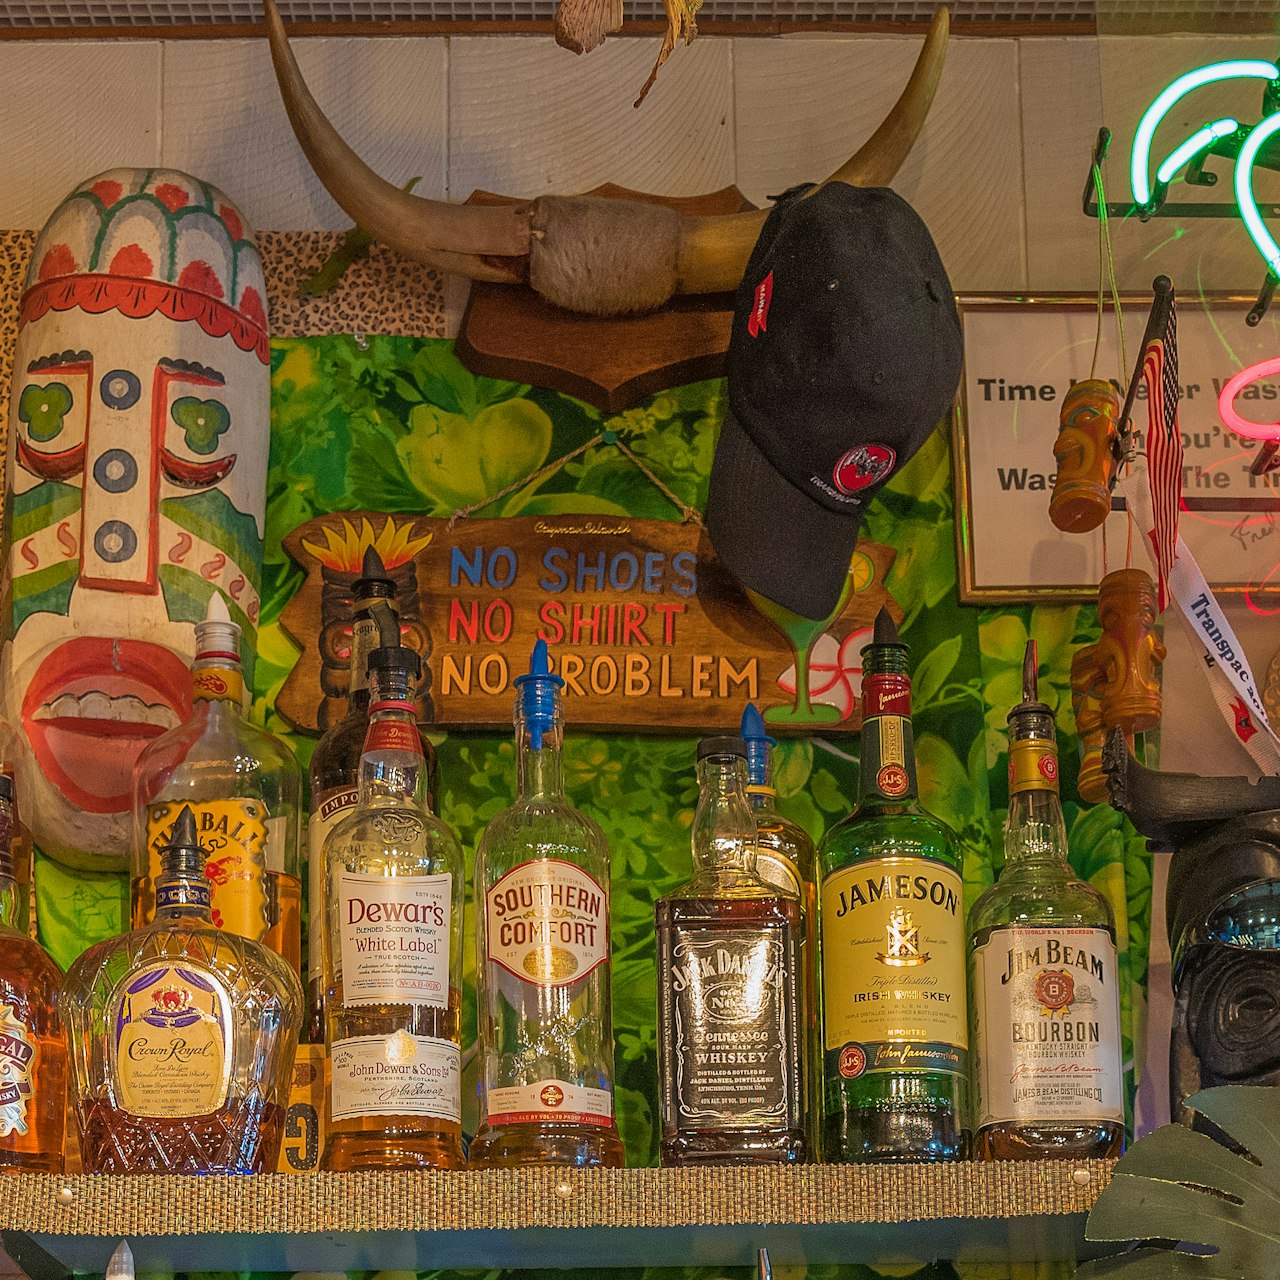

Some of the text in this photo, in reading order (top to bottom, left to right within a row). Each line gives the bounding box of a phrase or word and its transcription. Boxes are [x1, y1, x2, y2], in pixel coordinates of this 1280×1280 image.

[977, 377, 1057, 403] Time
[1108, 378, 1202, 402] Neer
[1179, 424, 1256, 450] ou're
[1182, 465, 1238, 489] The
[449, 545, 700, 596] NO SHOES
[447, 599, 687, 648] NO SHIRT
[1189, 592, 1251, 684] Transpac
[440, 652, 761, 699] NO ROBLEM
[493, 884, 601, 918] SOUTHERN
[836, 874, 957, 918] JAMESON
[348, 898, 444, 926] Dewar's
[500, 921, 597, 947] COMFORT
[1001, 939, 1105, 986] JIM BEAM
[694, 1030, 768, 1044] Tennessee
[1012, 1022, 1100, 1043] BOURBON
[129, 1037, 167, 1061] Crown
[694, 1052, 768, 1065] WHISKEY
[376, 1063, 411, 1074] Dewar
